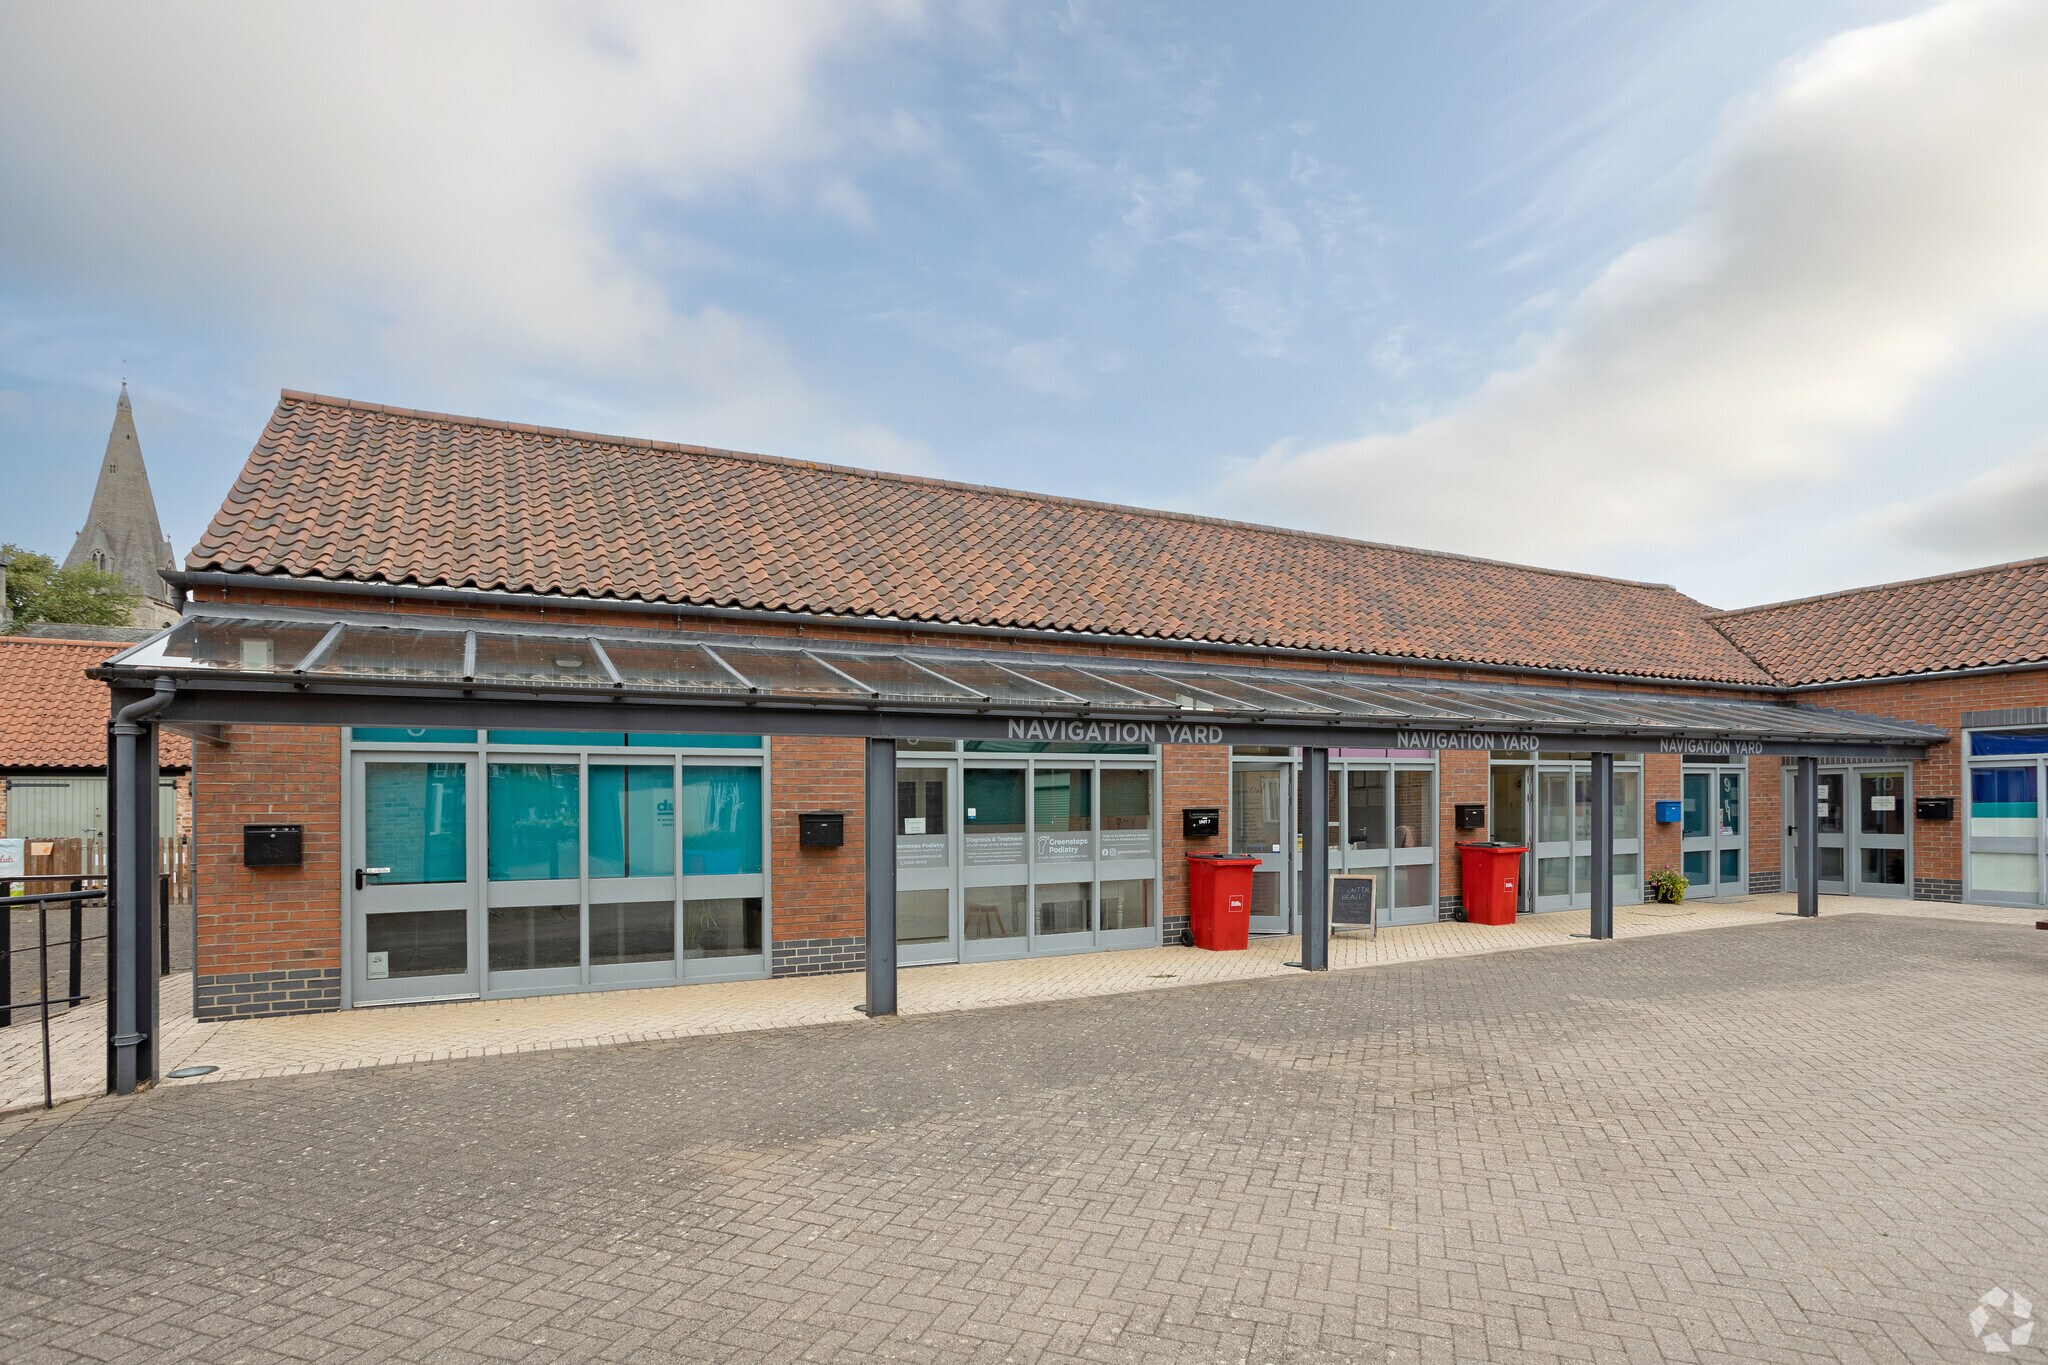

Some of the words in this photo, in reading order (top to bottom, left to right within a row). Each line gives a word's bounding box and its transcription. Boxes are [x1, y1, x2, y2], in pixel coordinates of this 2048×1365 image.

[1008, 719, 1156, 742] NAVIGATION
[1166, 724, 1223, 743] YARD
[1397, 732, 1494, 749] NAVIGATION
[1500, 734, 1540, 750] YARD
[1660, 739, 1730, 754] NAVIGATION
[1734, 741, 1763, 754] YARD
[1724, 777, 1731, 793] 9
[1872, 776, 1894, 791] 10
[1049, 838, 1088, 846] Greensteps
[1049, 846, 1079, 854] Podiatry
[1336, 886, 1371, 894] ESSENTIAL
[1341, 893, 1365, 901] BEAUTY
